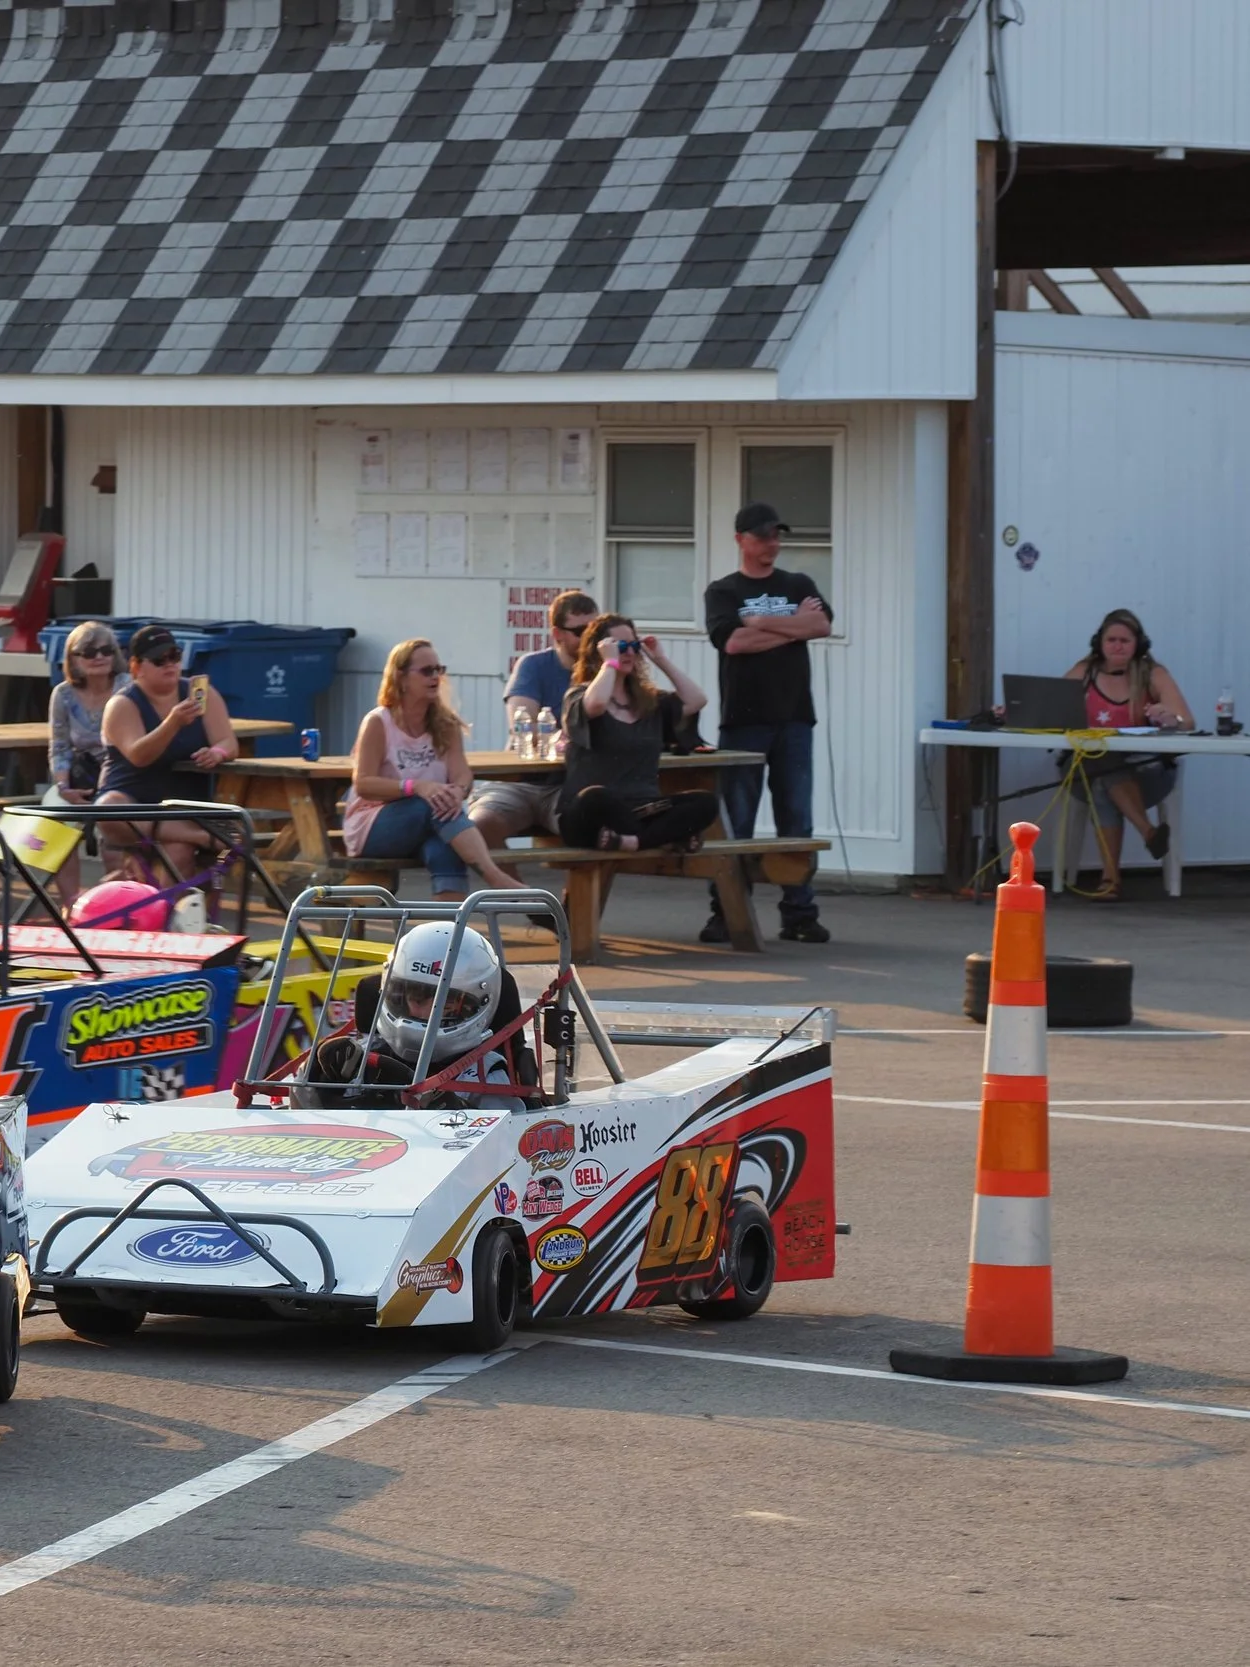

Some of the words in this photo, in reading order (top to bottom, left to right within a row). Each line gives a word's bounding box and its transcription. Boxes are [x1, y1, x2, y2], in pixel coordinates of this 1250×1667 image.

[509, 587, 522, 605] ALL
[507, 610, 543, 628] PATRONS
[68, 991, 207, 1044] Showcase
[81, 1041, 135, 1062] AUTO
[139, 1031, 198, 1054] SALES
[152, 1132, 390, 1159] PERFORMANCE
[526, 1126, 575, 1154] DAVIS
[579, 1116, 637, 1153] Hoosier
[176, 1152, 362, 1174] Plumbing
[528, 1149, 575, 1173] Racing
[124, 1178, 374, 1197] 6-516-6305
[575, 1167, 603, 1186] BELL
[639, 1143, 735, 1270] 88
[157, 1230, 239, 1260] Ford
[541, 1239, 583, 1260] LANDRUM
